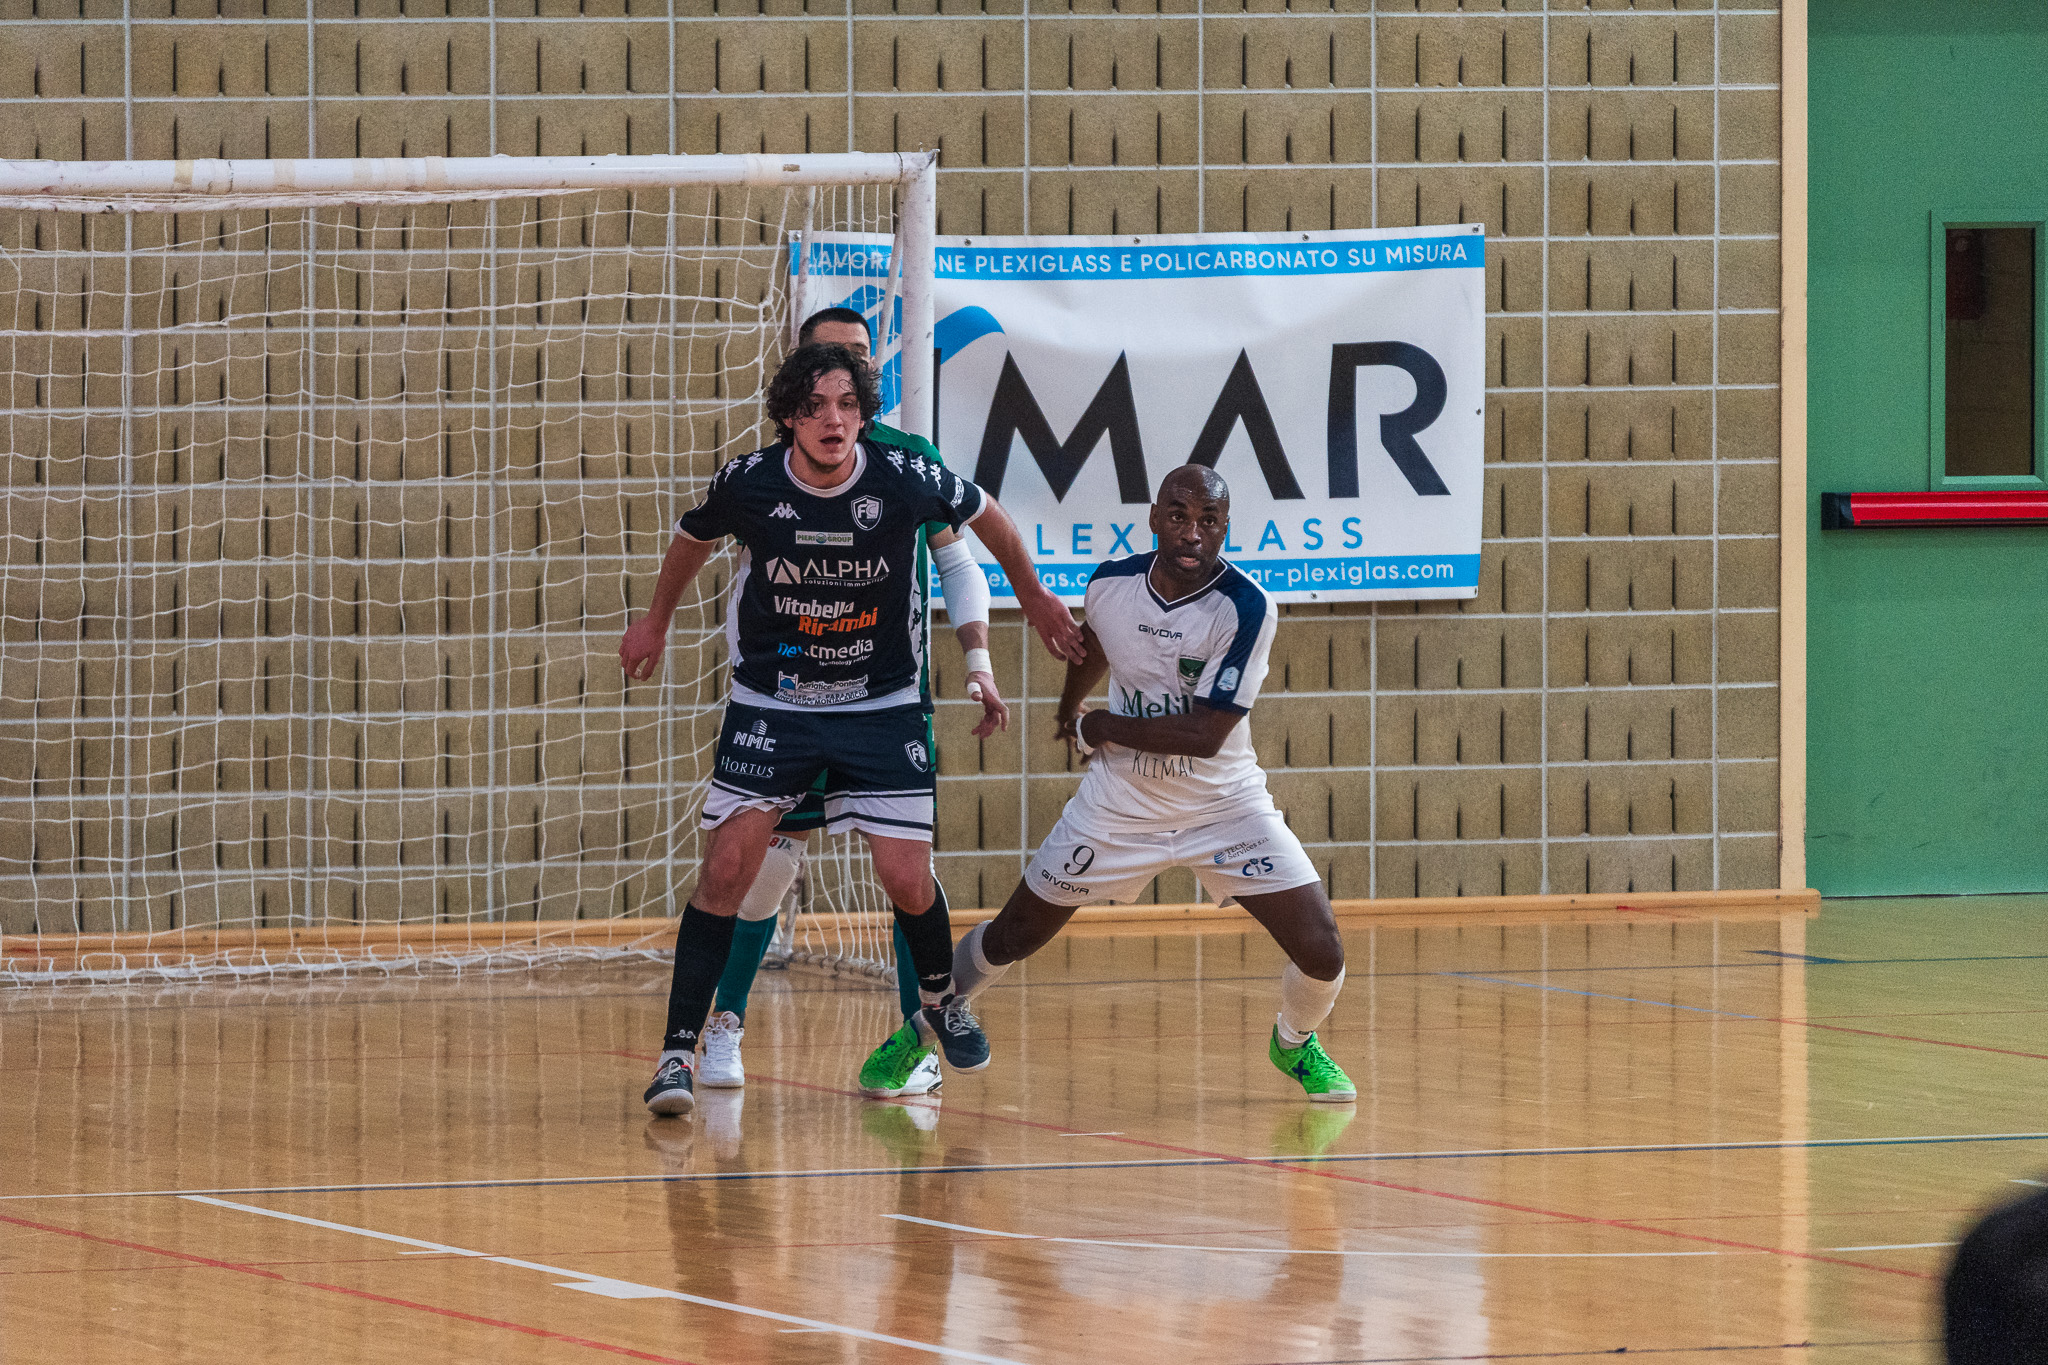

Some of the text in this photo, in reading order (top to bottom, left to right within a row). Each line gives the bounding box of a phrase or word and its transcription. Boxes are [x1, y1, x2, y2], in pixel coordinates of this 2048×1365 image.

[975, 253, 1112, 274] PLEXIGLASS
[1121, 253, 1132, 273] E
[1141, 249, 1338, 272] POLICARBONATO
[1347, 247, 1376, 267] SU
[1386, 242, 1468, 265] MISURA
[797, 534, 853, 543] PIERI GROUP
[802, 555, 890, 579] ALPHA
[804, 579, 842, 587] soluzioni
[774, 595, 855, 619] Vitobella
[798, 607, 879, 637] Ricambi
[1138, 623, 1183, 641] GIVOVA
[777, 639, 874, 660] nextmedia
[732, 731, 777, 752] NMC
[1063, 844, 1095, 876] 9
[1041, 869, 1090, 896] GIVOVA
